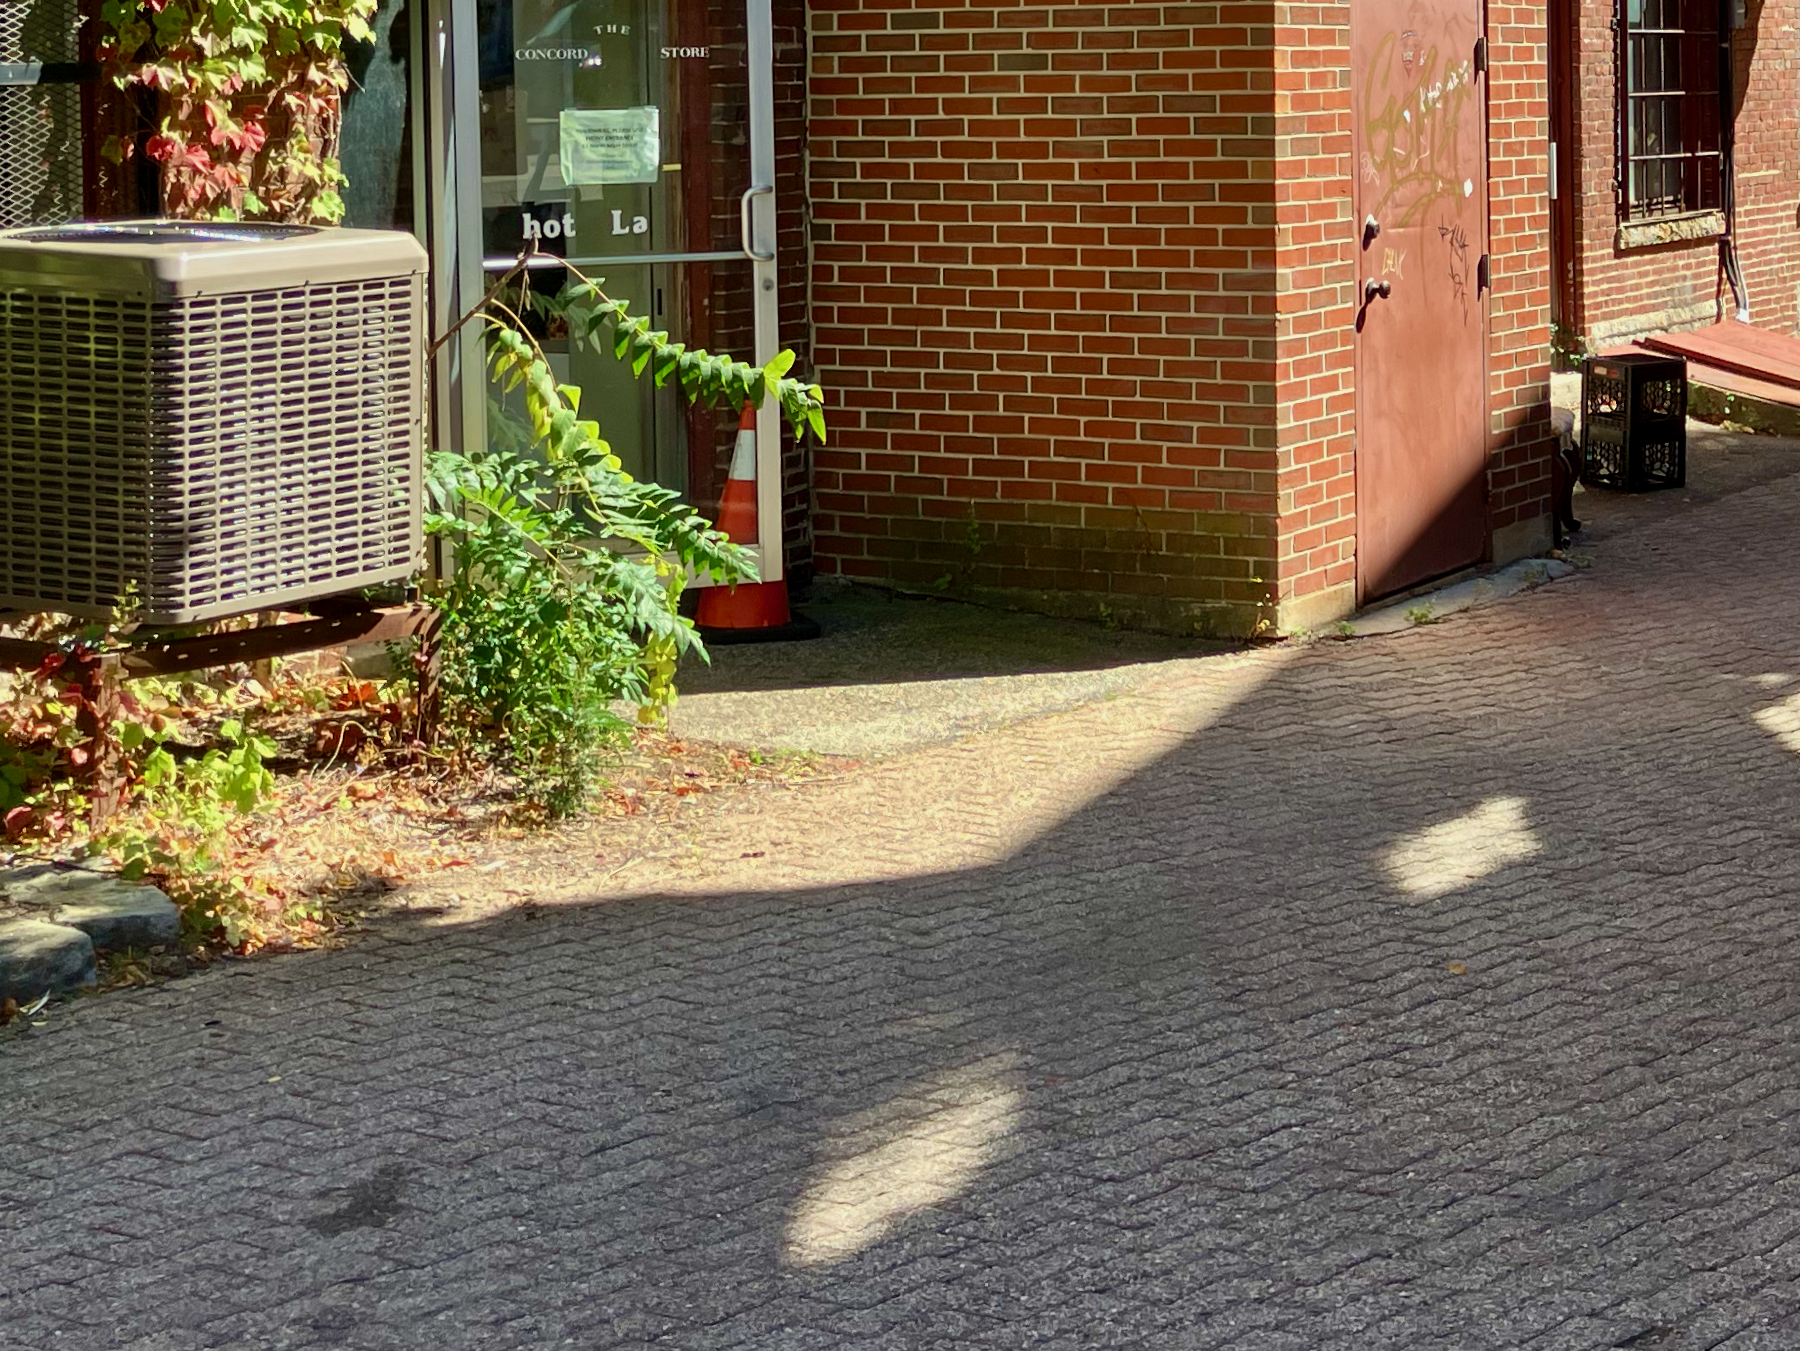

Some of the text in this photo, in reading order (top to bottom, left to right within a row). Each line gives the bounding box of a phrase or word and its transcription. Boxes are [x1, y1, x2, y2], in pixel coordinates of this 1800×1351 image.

[593, 24, 630, 36] THE
[515, 46, 710, 61] CONCORD STORE
[522, 210, 648, 239] hot La
